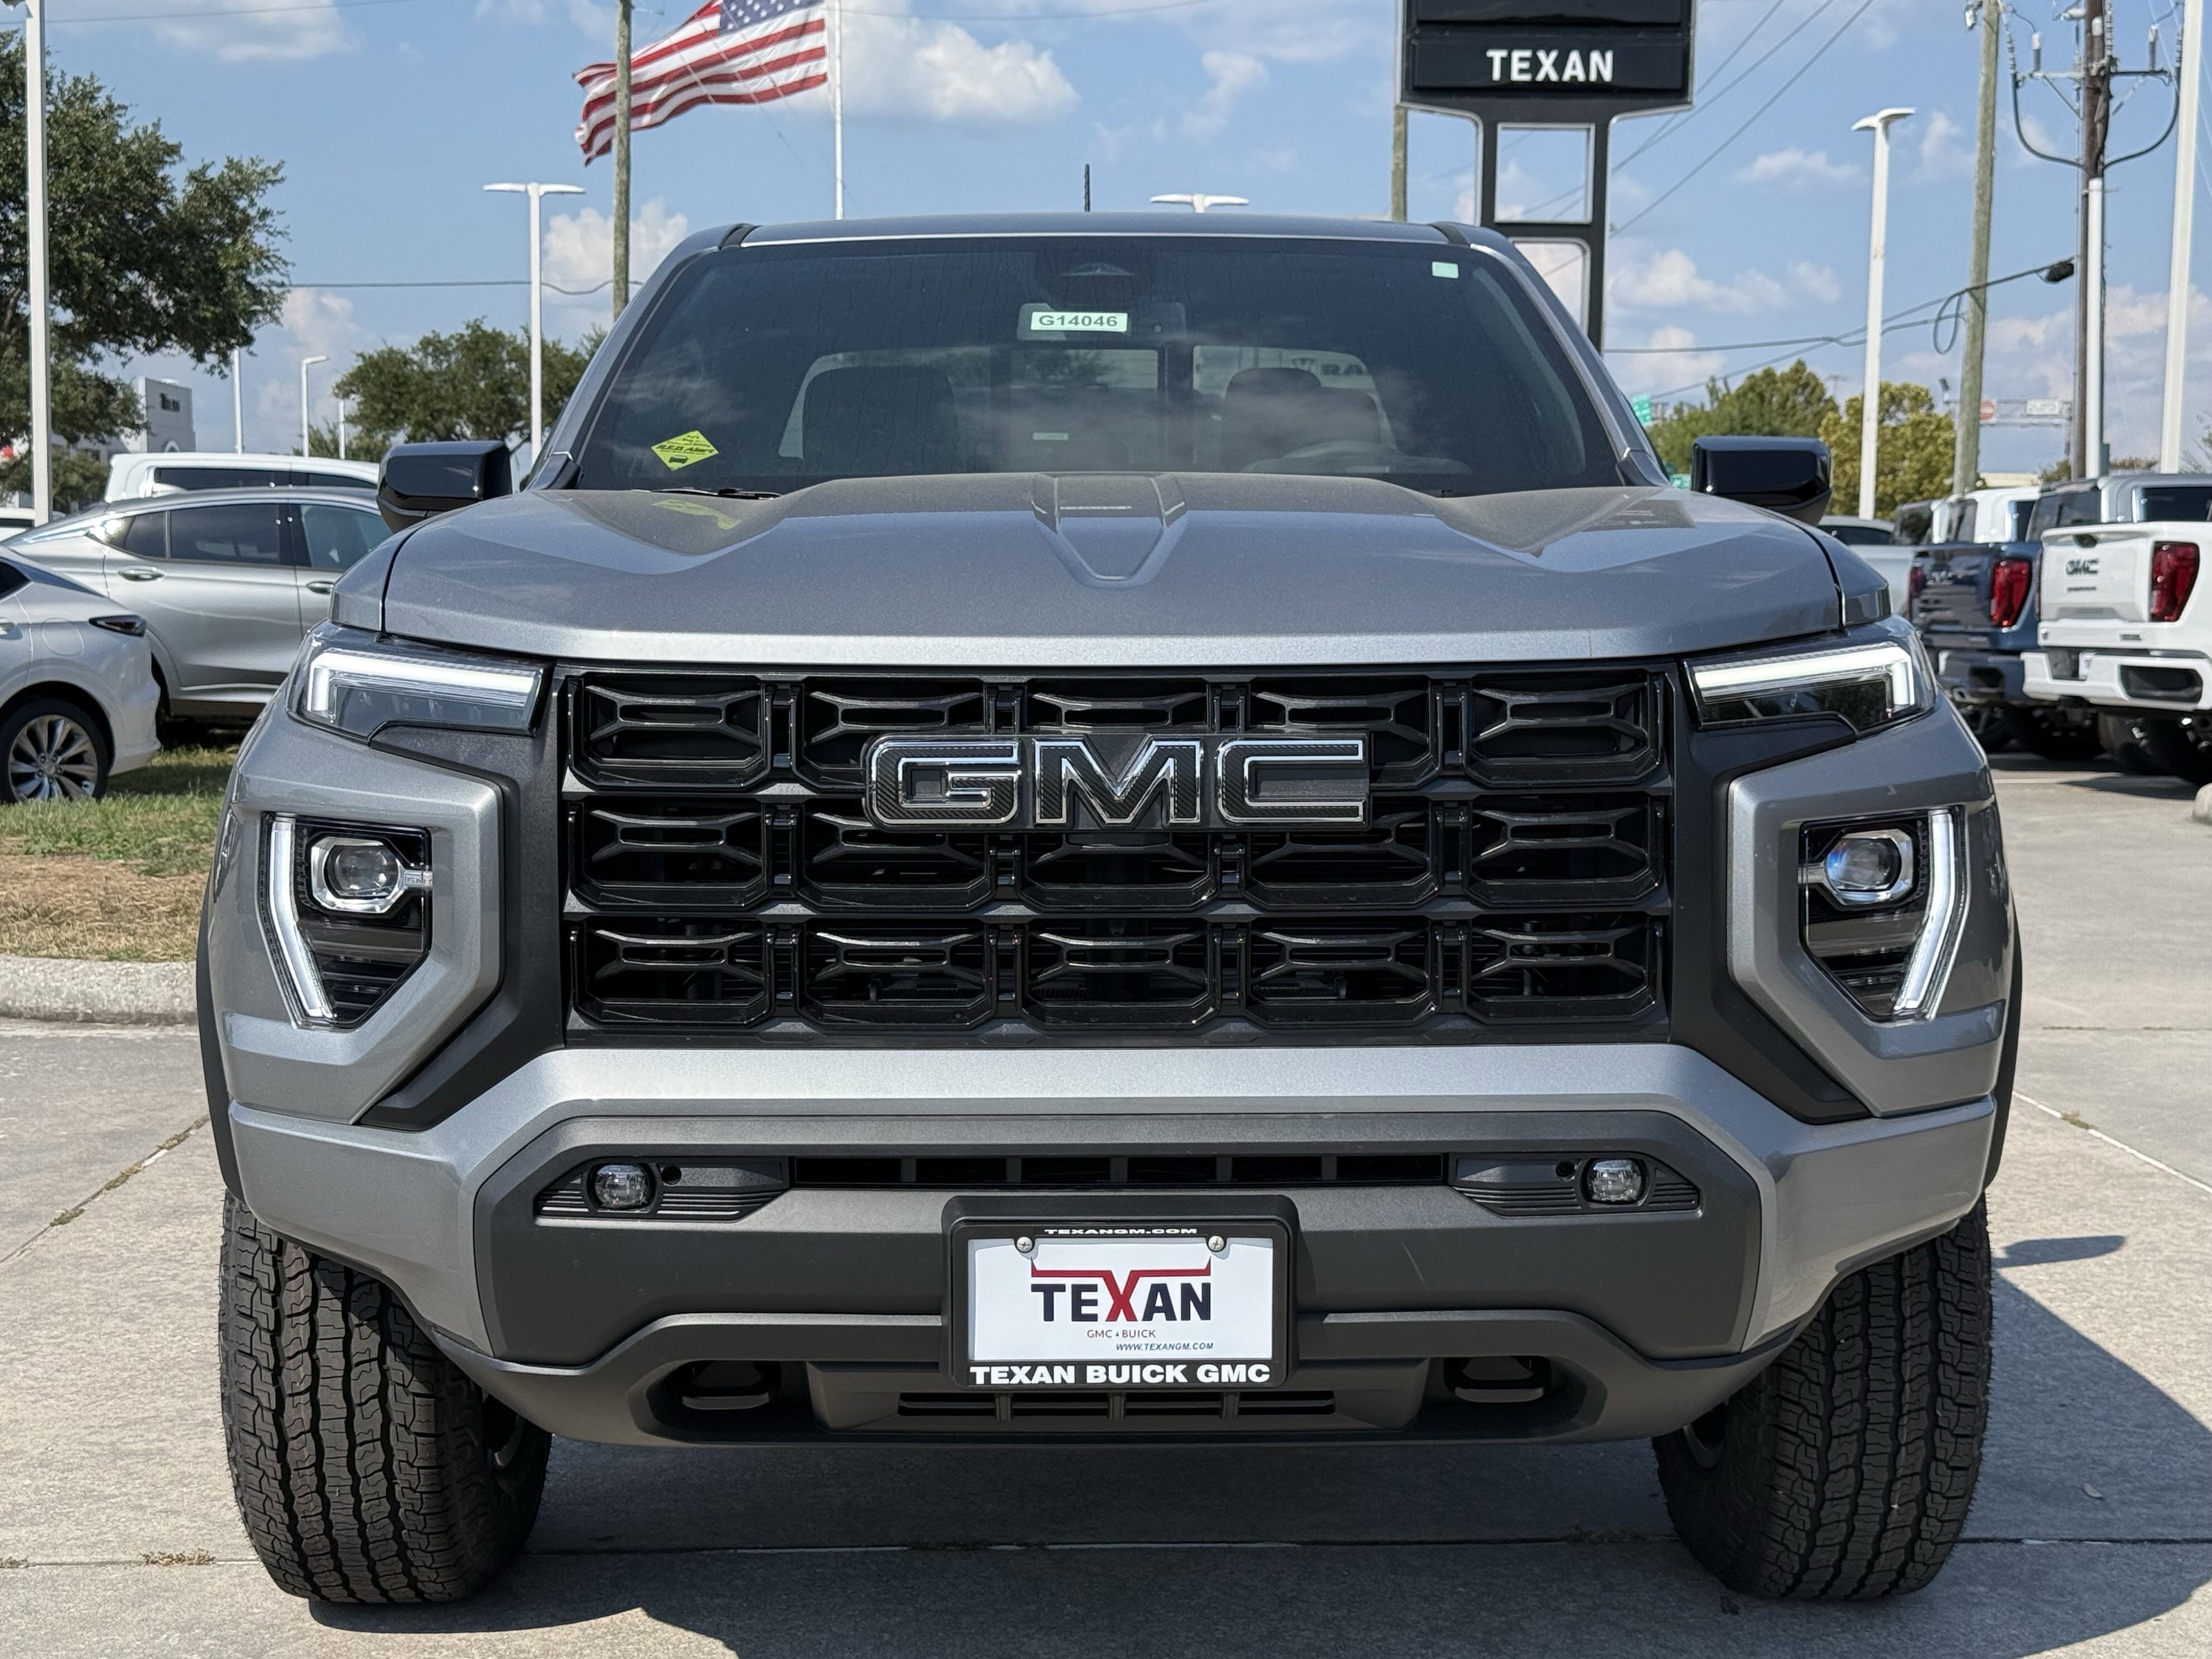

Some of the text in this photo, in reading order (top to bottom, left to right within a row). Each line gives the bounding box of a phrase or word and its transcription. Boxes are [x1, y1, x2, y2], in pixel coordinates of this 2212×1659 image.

[1486, 49, 1614, 83] TEXAN
[1039, 315, 1118, 327] G14046
[2066, 558, 2101, 575] GMC
[871, 737, 1365, 826] GMC
[1031, 1269, 1211, 1322] TEXAN
[1087, 1329, 1156, 1338] GMC BUICK
[1116, 1342, 1214, 1351] WWW.TEXANGM.COM
[969, 1364, 1270, 1385] TEXAN BUICK GMC
